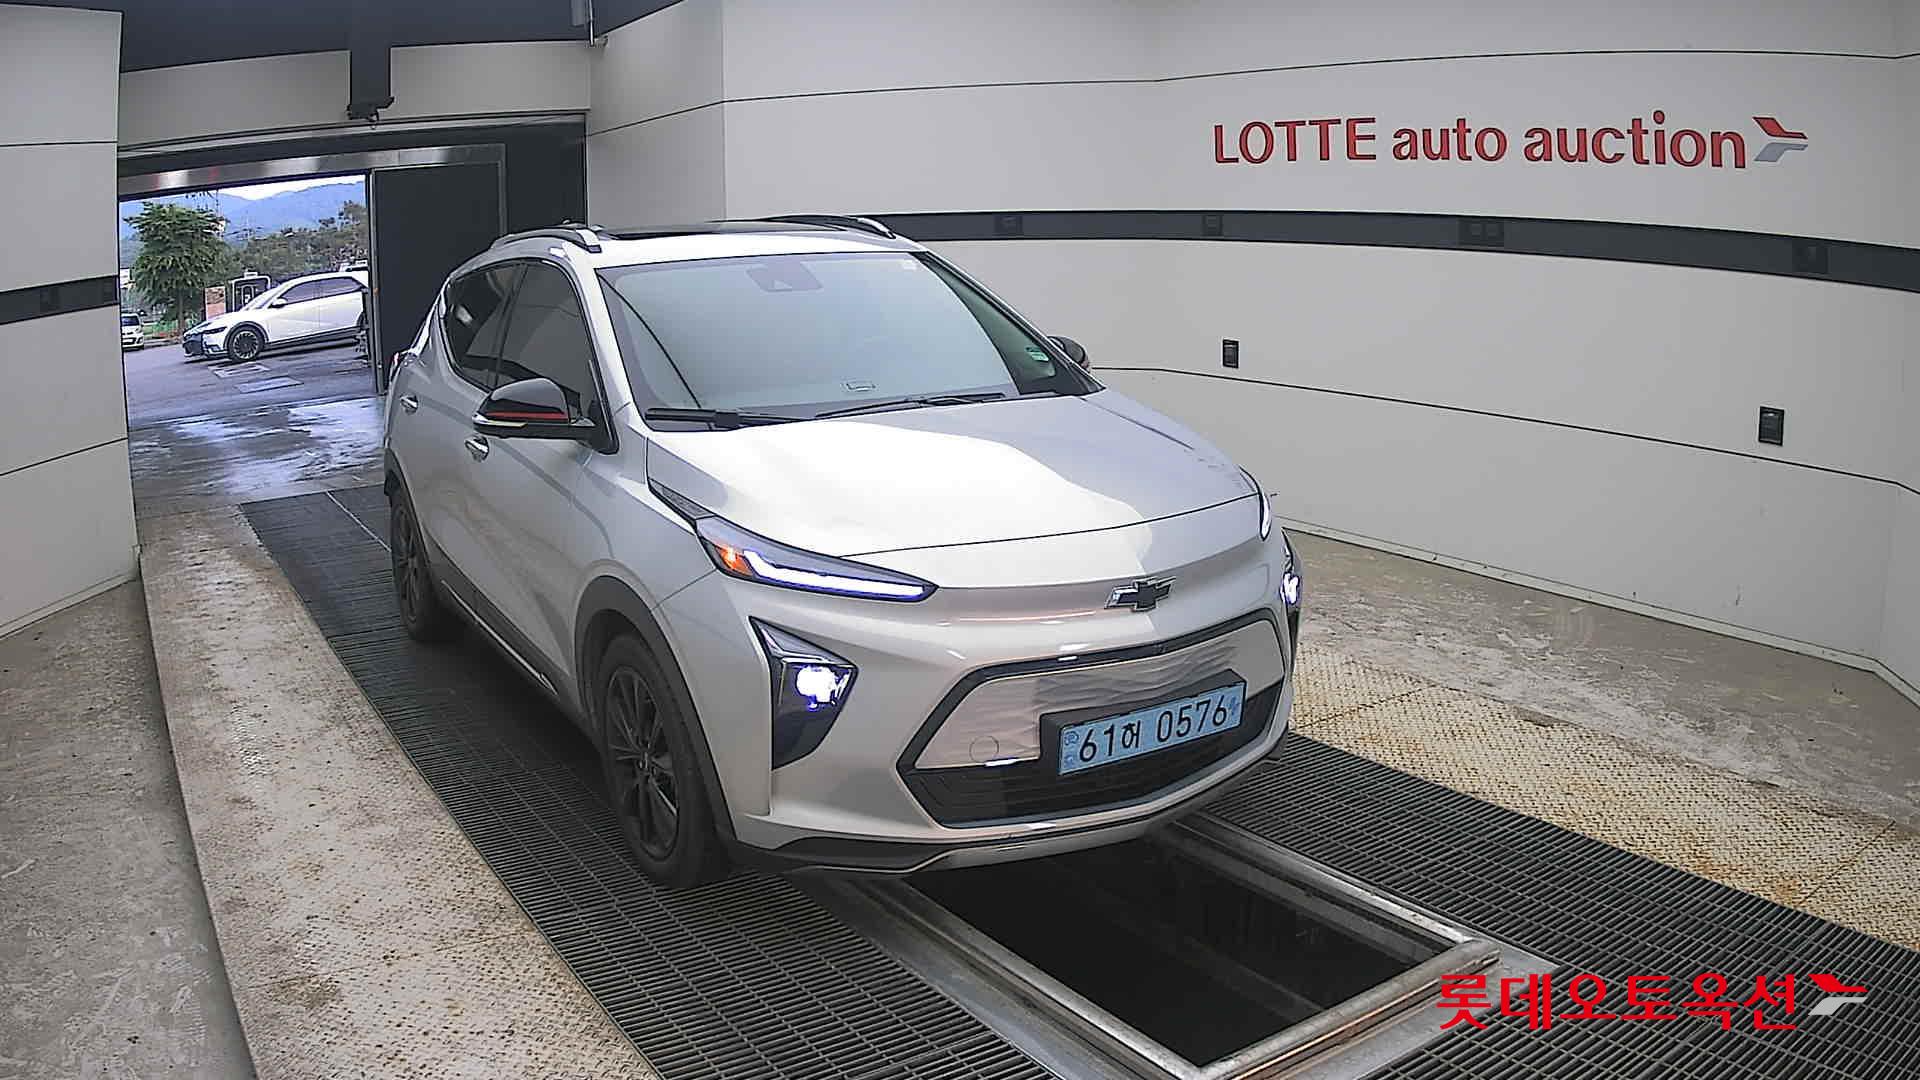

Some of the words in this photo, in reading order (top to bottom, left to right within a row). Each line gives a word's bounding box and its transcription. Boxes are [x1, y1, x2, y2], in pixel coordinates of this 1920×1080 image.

[1213, 117, 1377, 164] LOTTE
[1392, 117, 1508, 161] auto
[1523, 110, 1747, 169] auction
[1079, 719, 1141, 762] 61허
[1156, 695, 1228, 743] 0576
